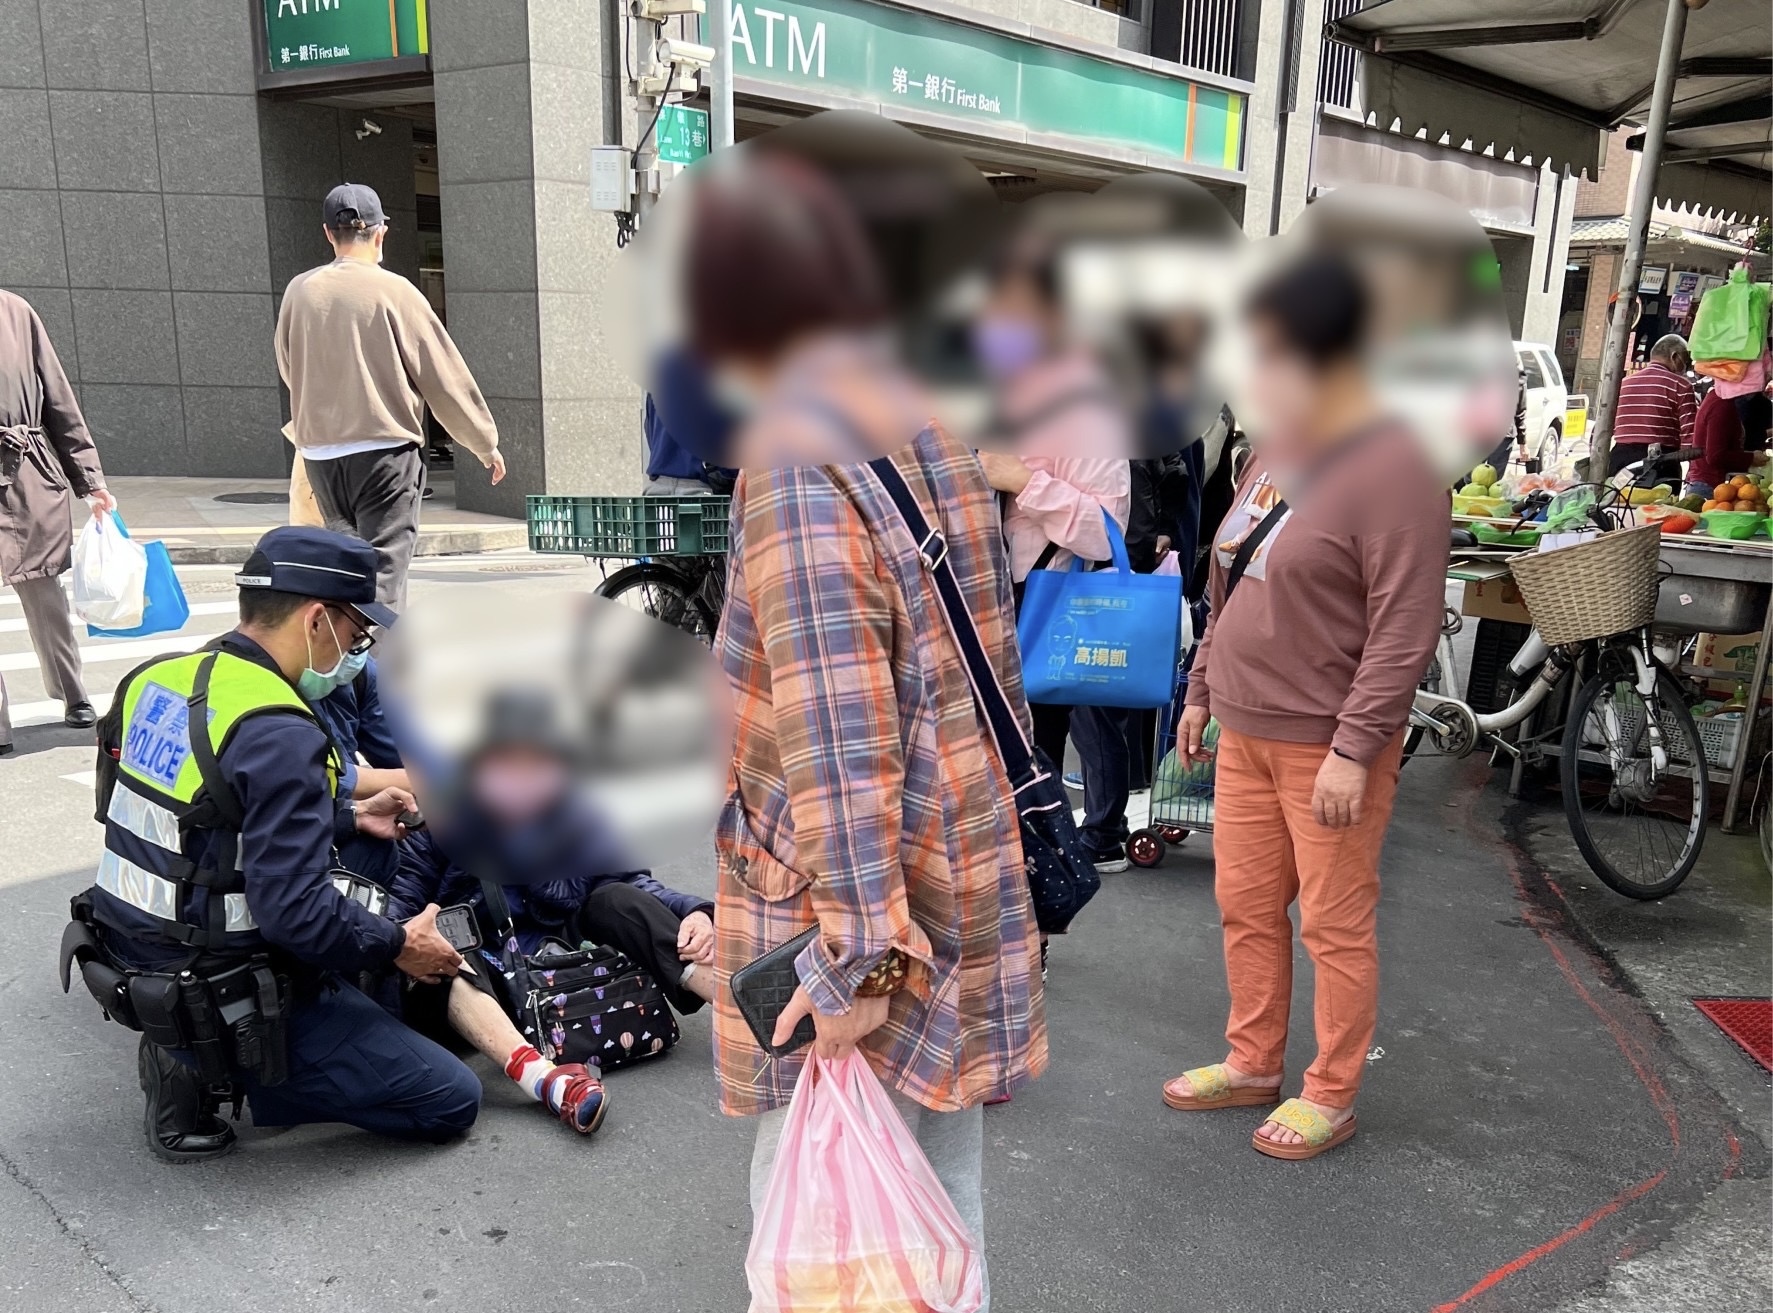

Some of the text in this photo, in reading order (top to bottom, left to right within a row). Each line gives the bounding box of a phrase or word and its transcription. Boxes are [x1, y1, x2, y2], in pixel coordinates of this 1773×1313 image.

[281, 44, 350, 63] 第一銀行 First Bank
[732, 3, 825, 78] ATM
[892, 66, 1001, 114] 第一銀行 First Bank
[126, 724, 185, 780] POLICE
